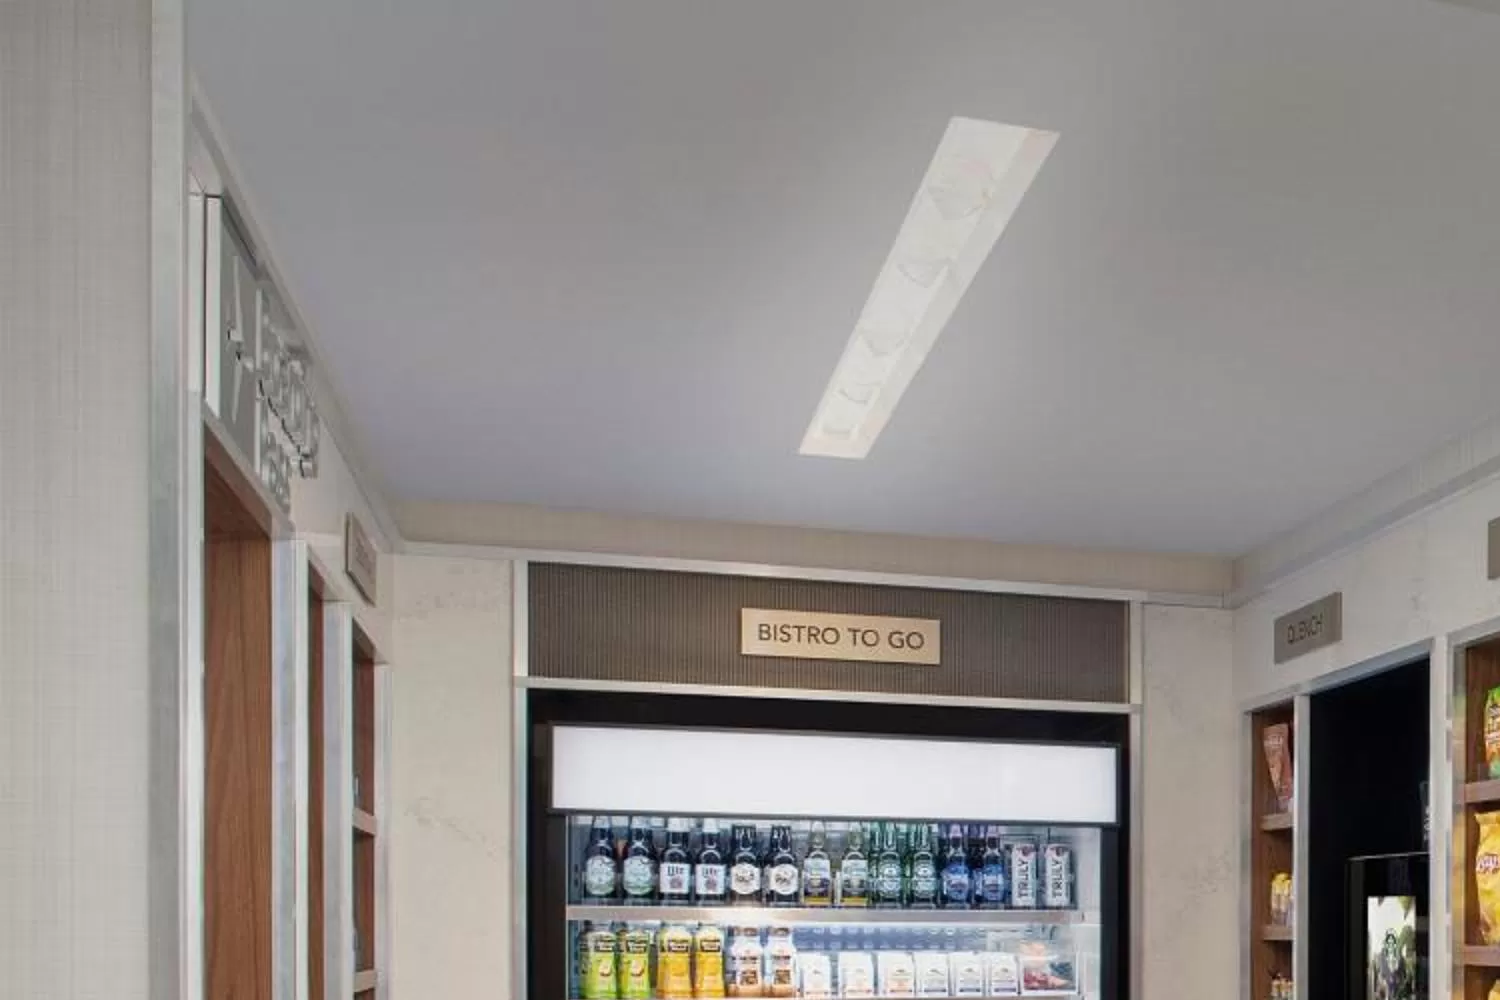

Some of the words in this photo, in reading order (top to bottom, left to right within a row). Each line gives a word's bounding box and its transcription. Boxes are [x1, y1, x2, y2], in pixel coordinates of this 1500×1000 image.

[758, 623, 840, 645] BISTRO
[847, 627, 880, 647] TO
[887, 631, 925, 650] GO
